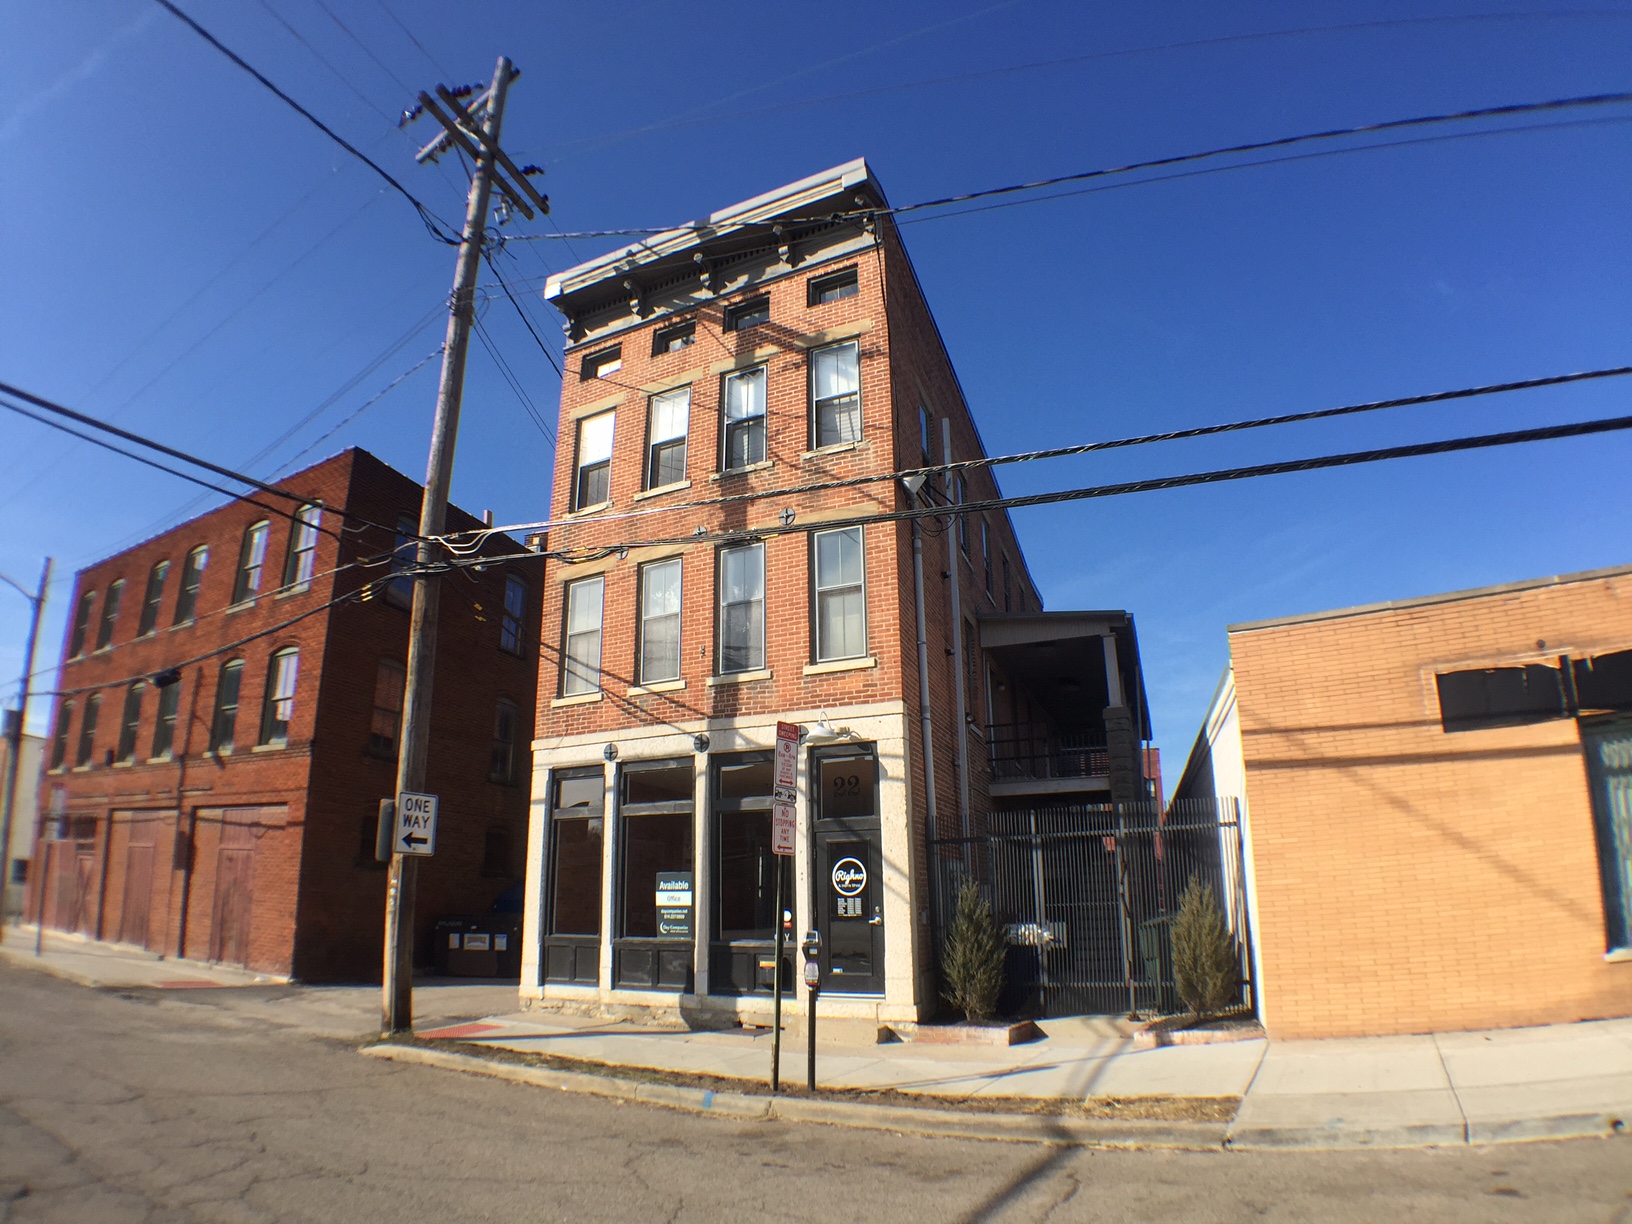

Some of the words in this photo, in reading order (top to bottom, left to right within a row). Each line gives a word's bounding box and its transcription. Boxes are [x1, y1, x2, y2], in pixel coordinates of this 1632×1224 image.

[781, 724, 795, 732] STREET
[778, 730, 797, 740] SWEEPING
[833, 775, 860, 797] 22
[405, 798, 430, 813] ONE
[781, 809, 790, 818] NO
[402, 814, 430, 829] WAY
[775, 818, 795, 828] STOPPING
[780, 835, 790, 843] TIME
[659, 880, 689, 890] Available
